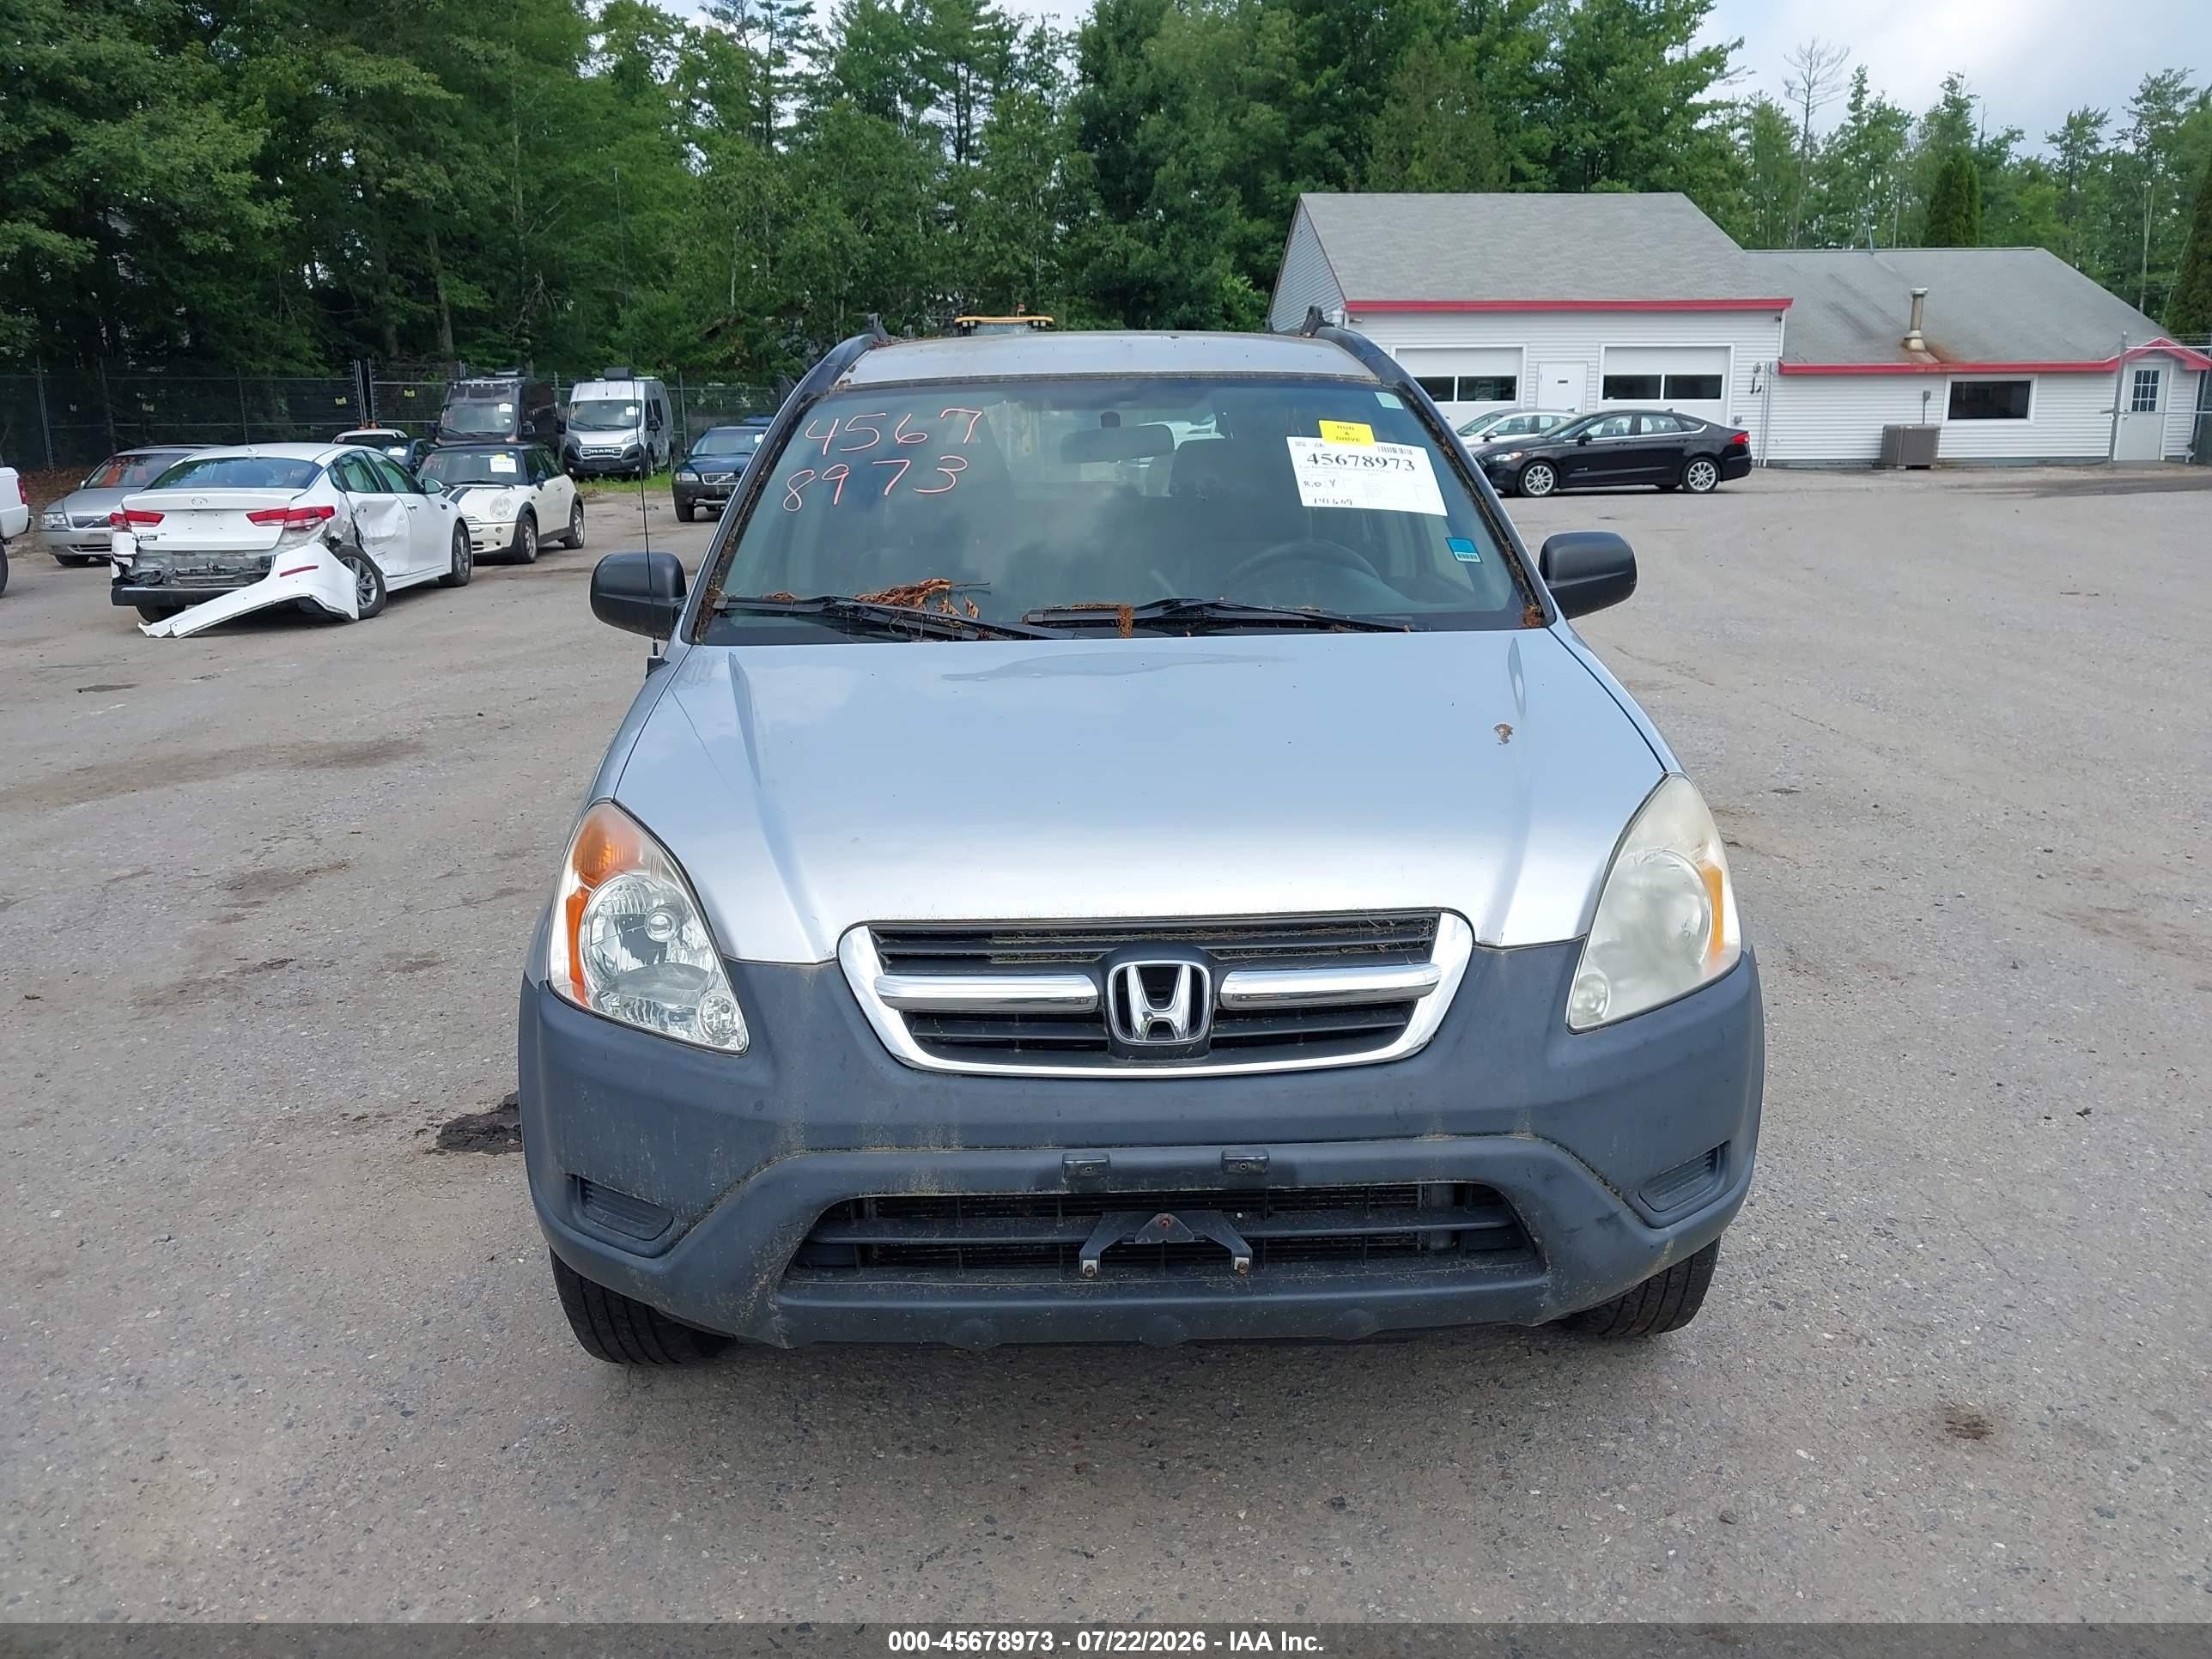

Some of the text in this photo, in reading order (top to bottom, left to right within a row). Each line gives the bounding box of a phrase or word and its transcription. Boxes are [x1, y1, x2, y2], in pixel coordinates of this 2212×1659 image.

[805, 407, 983, 456] 4567
[782, 455, 968, 512] 8973
[1306, 453, 1416, 471] 45678973
